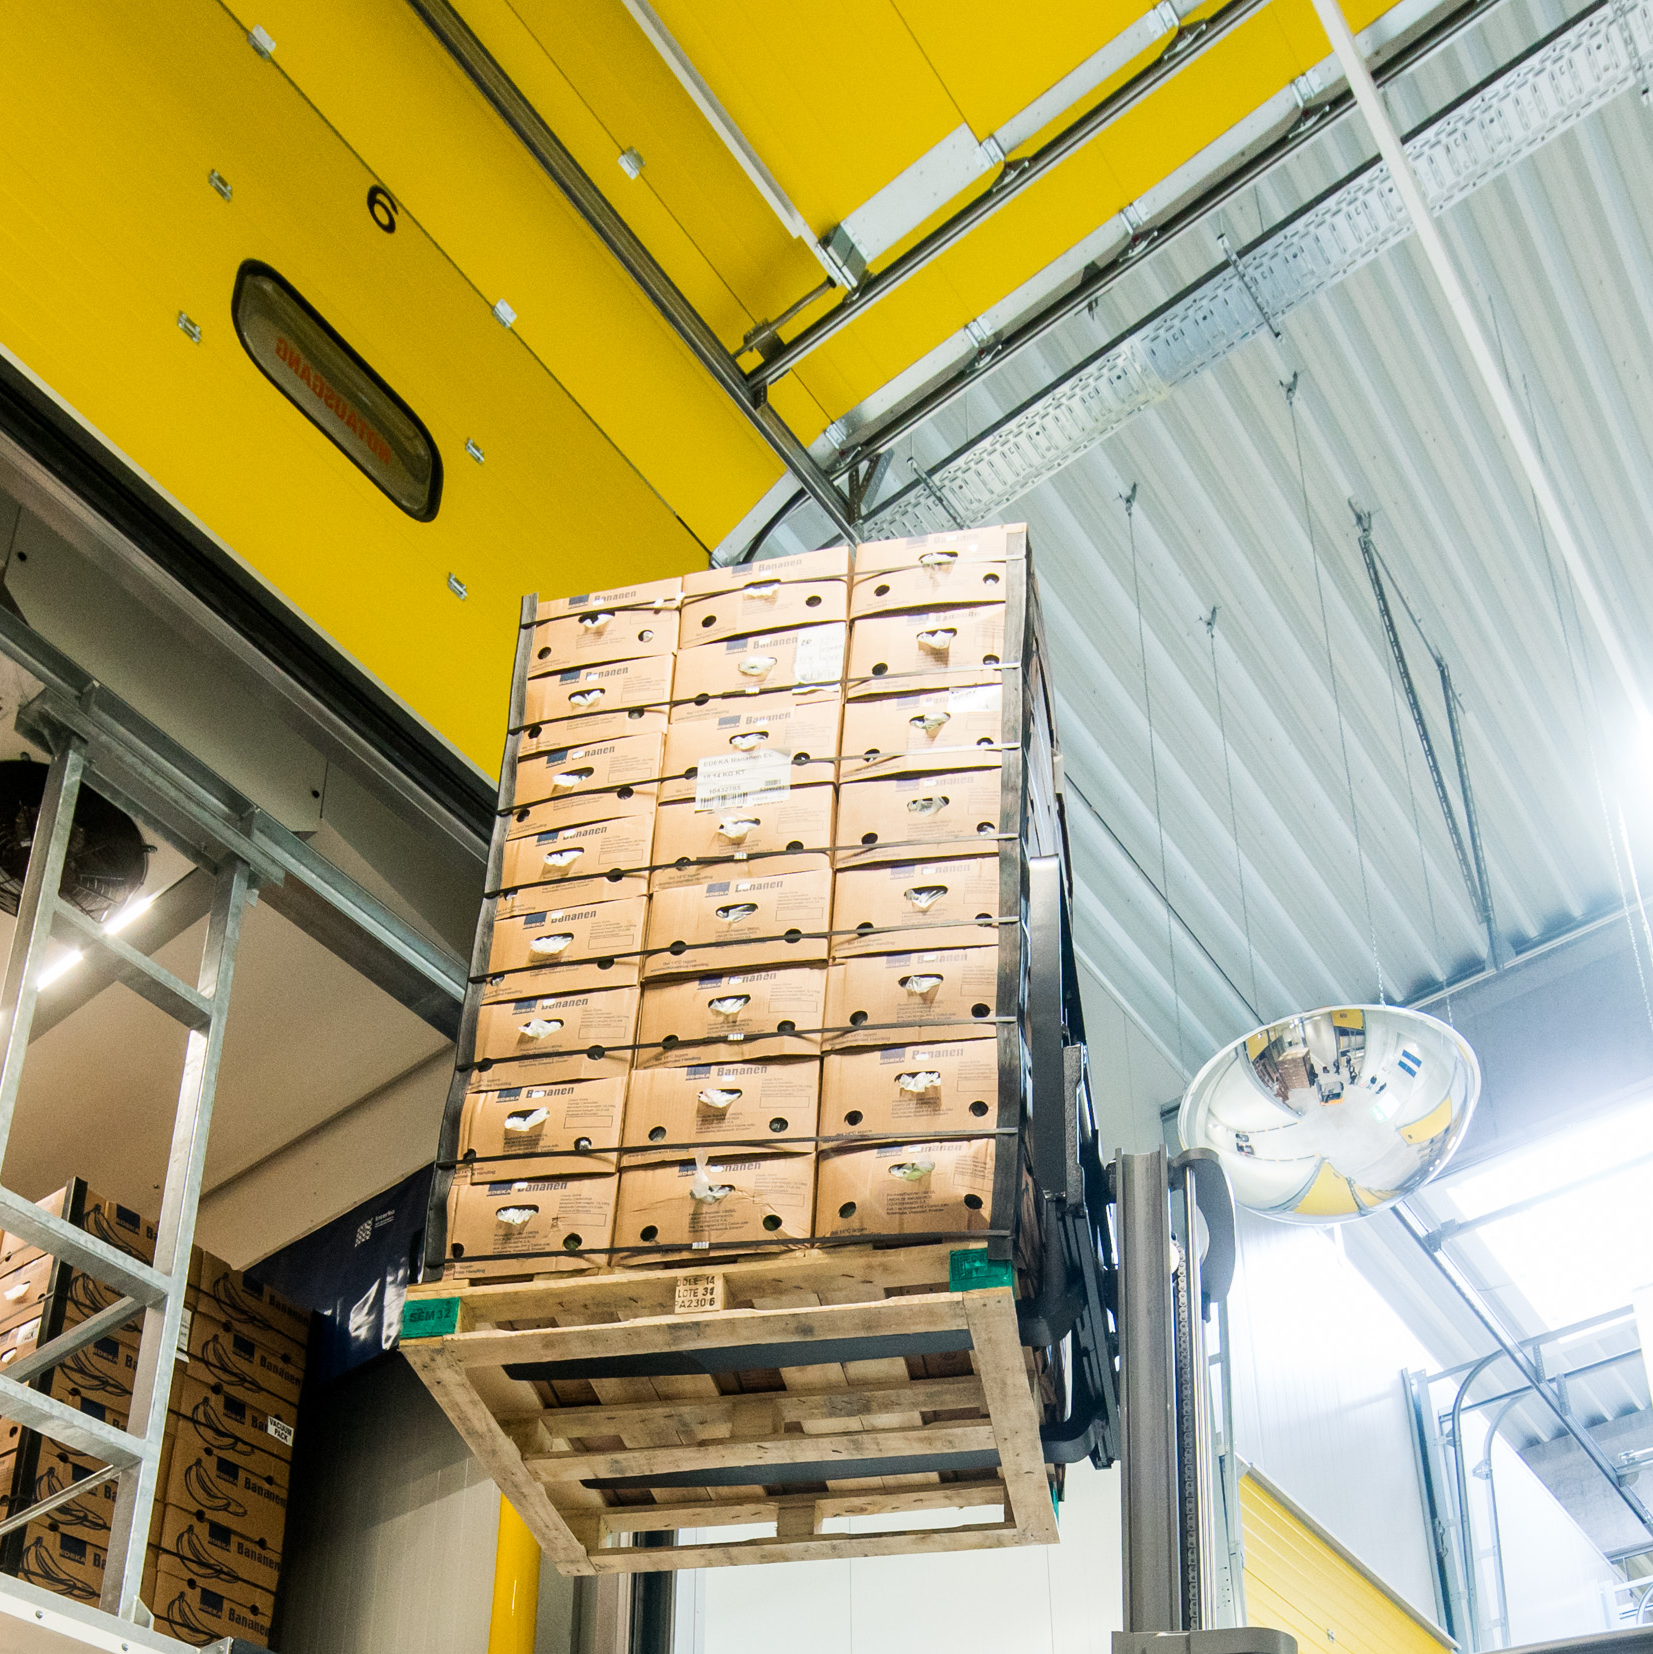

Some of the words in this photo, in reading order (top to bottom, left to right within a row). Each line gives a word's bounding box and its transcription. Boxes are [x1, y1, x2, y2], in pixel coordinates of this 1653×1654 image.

[716, 1066, 768, 1078] Bananen
[678, 1288, 698, 1298] LOTE
[269, 1418, 292, 1437] VACUUM
[274, 1428, 289, 1443] PACK
